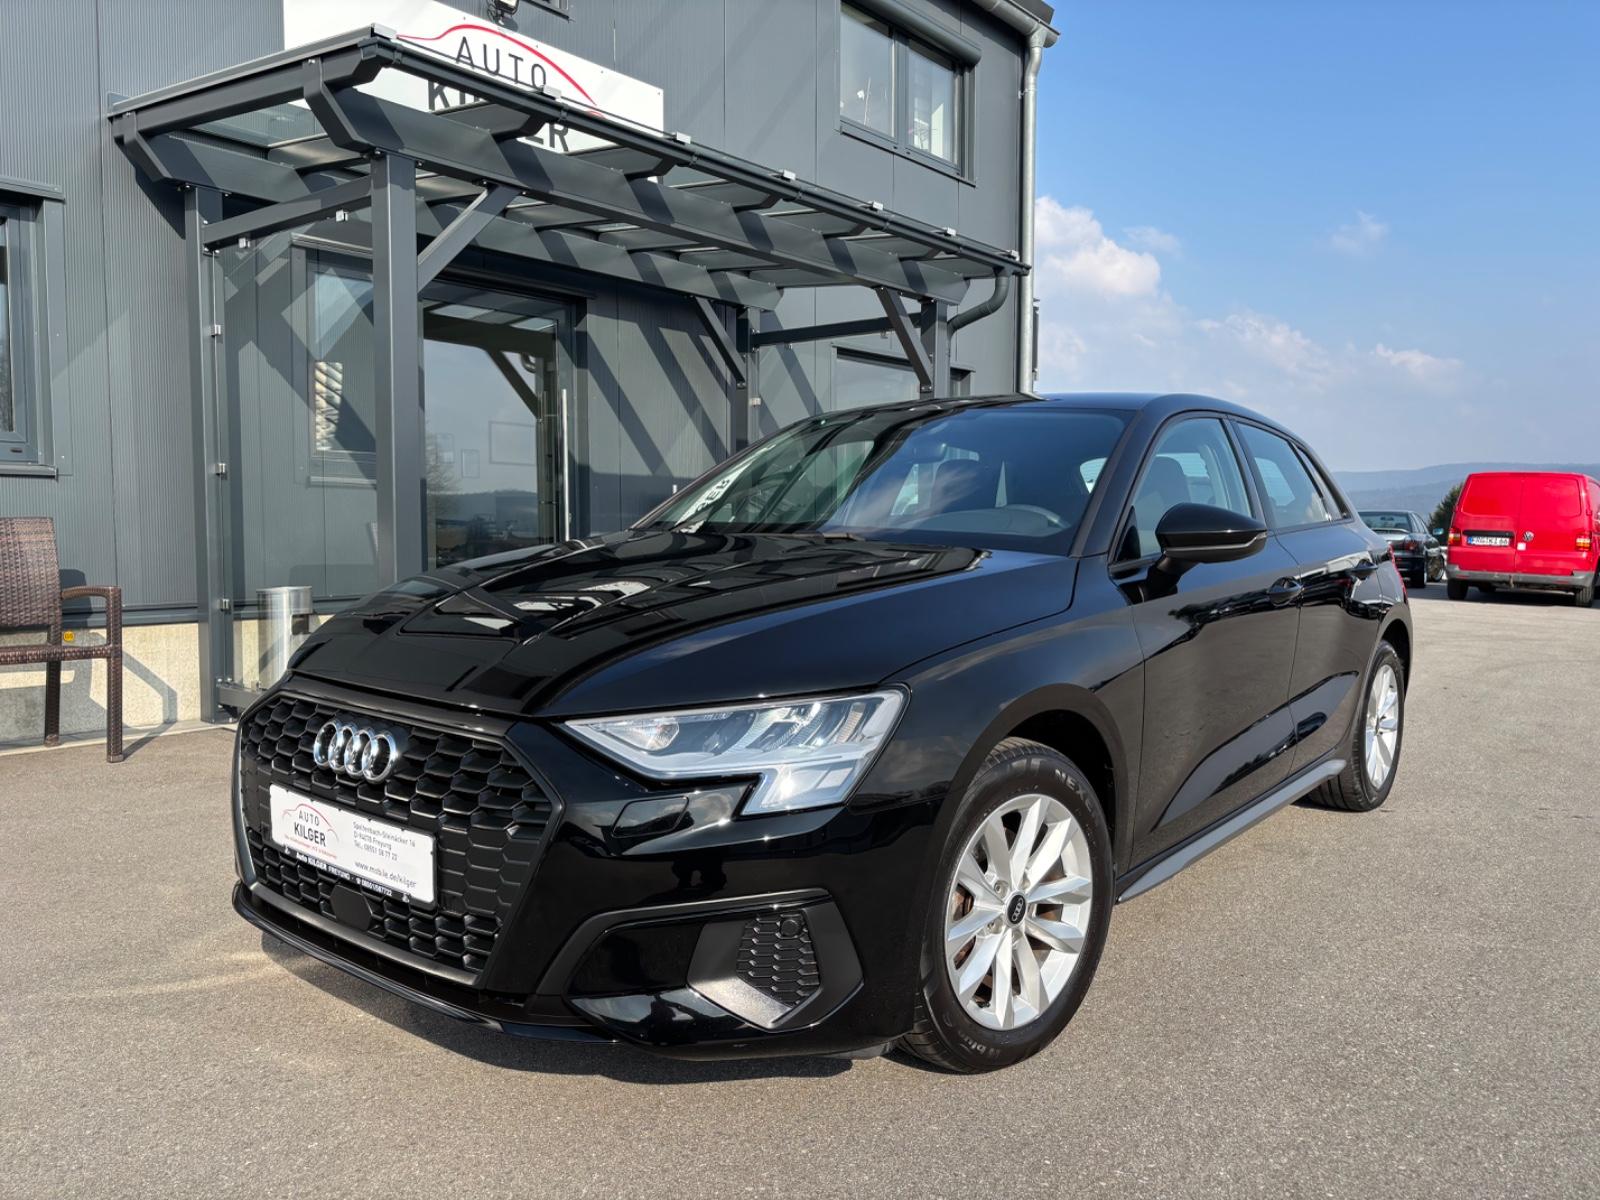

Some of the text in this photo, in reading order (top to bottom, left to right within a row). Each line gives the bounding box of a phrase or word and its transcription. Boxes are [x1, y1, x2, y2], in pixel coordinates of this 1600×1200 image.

[455, 35, 547, 92] AUTO
[298, 809, 320, 827] AUTO
[294, 821, 327, 847] KILGER
